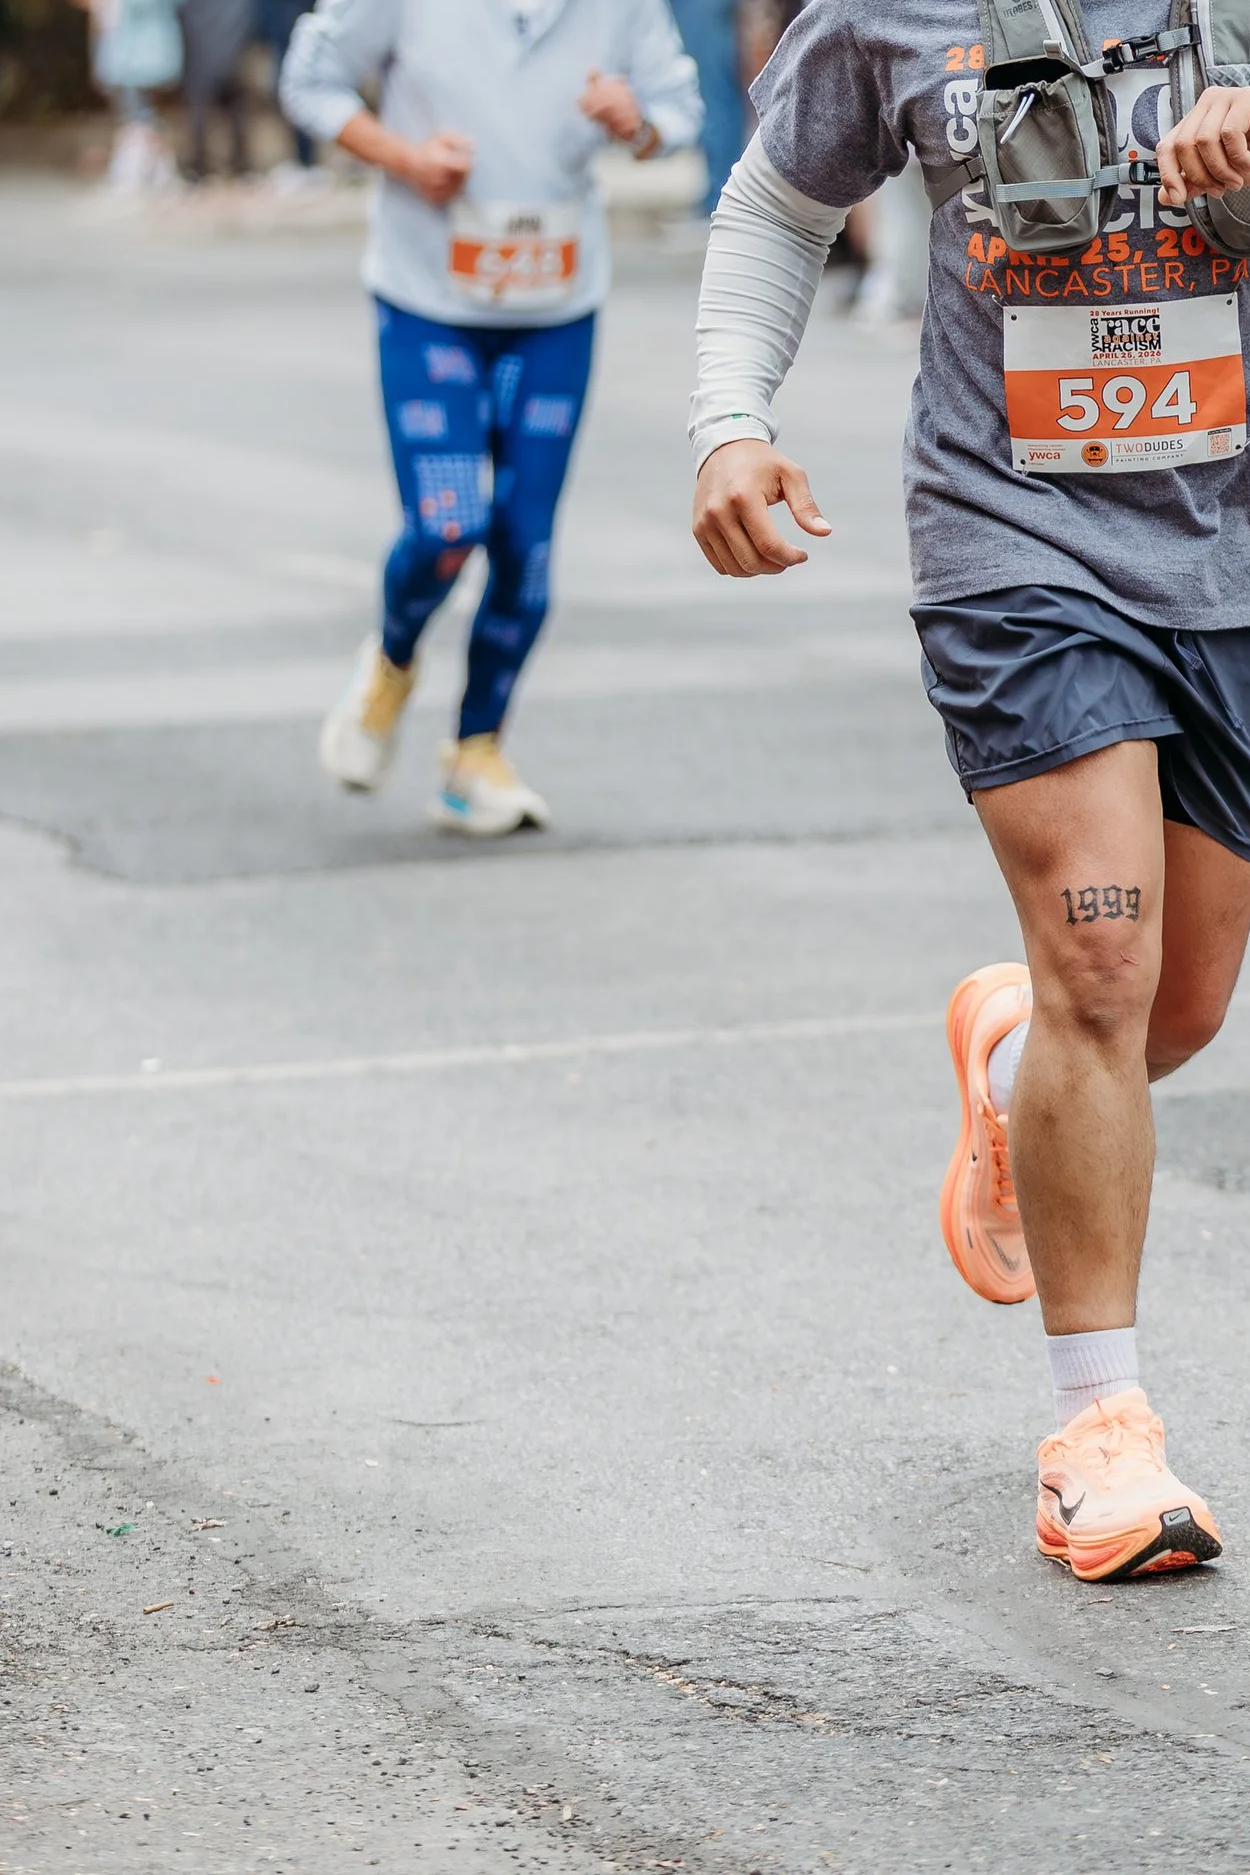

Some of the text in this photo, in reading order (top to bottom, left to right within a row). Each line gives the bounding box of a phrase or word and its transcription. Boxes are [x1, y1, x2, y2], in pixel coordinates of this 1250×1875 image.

[945, 44, 984, 71] 28
[1081, 233, 1143, 264] 25,
[965, 258, 1249, 298] LANCASTER, PA
[1102, 309, 1122, 317] Years
[1124, 307, 1160, 315] Running!
[1090, 318, 1103, 352] ywca
[1101, 317, 1160, 336] race
[1093, 352, 1119, 360] APRIL
[1102, 340, 1161, 353] RACISM
[1056, 370, 1197, 432] 594
[1028, 451, 1061, 461] ywca
[1060, 884, 1142, 926] 1999
